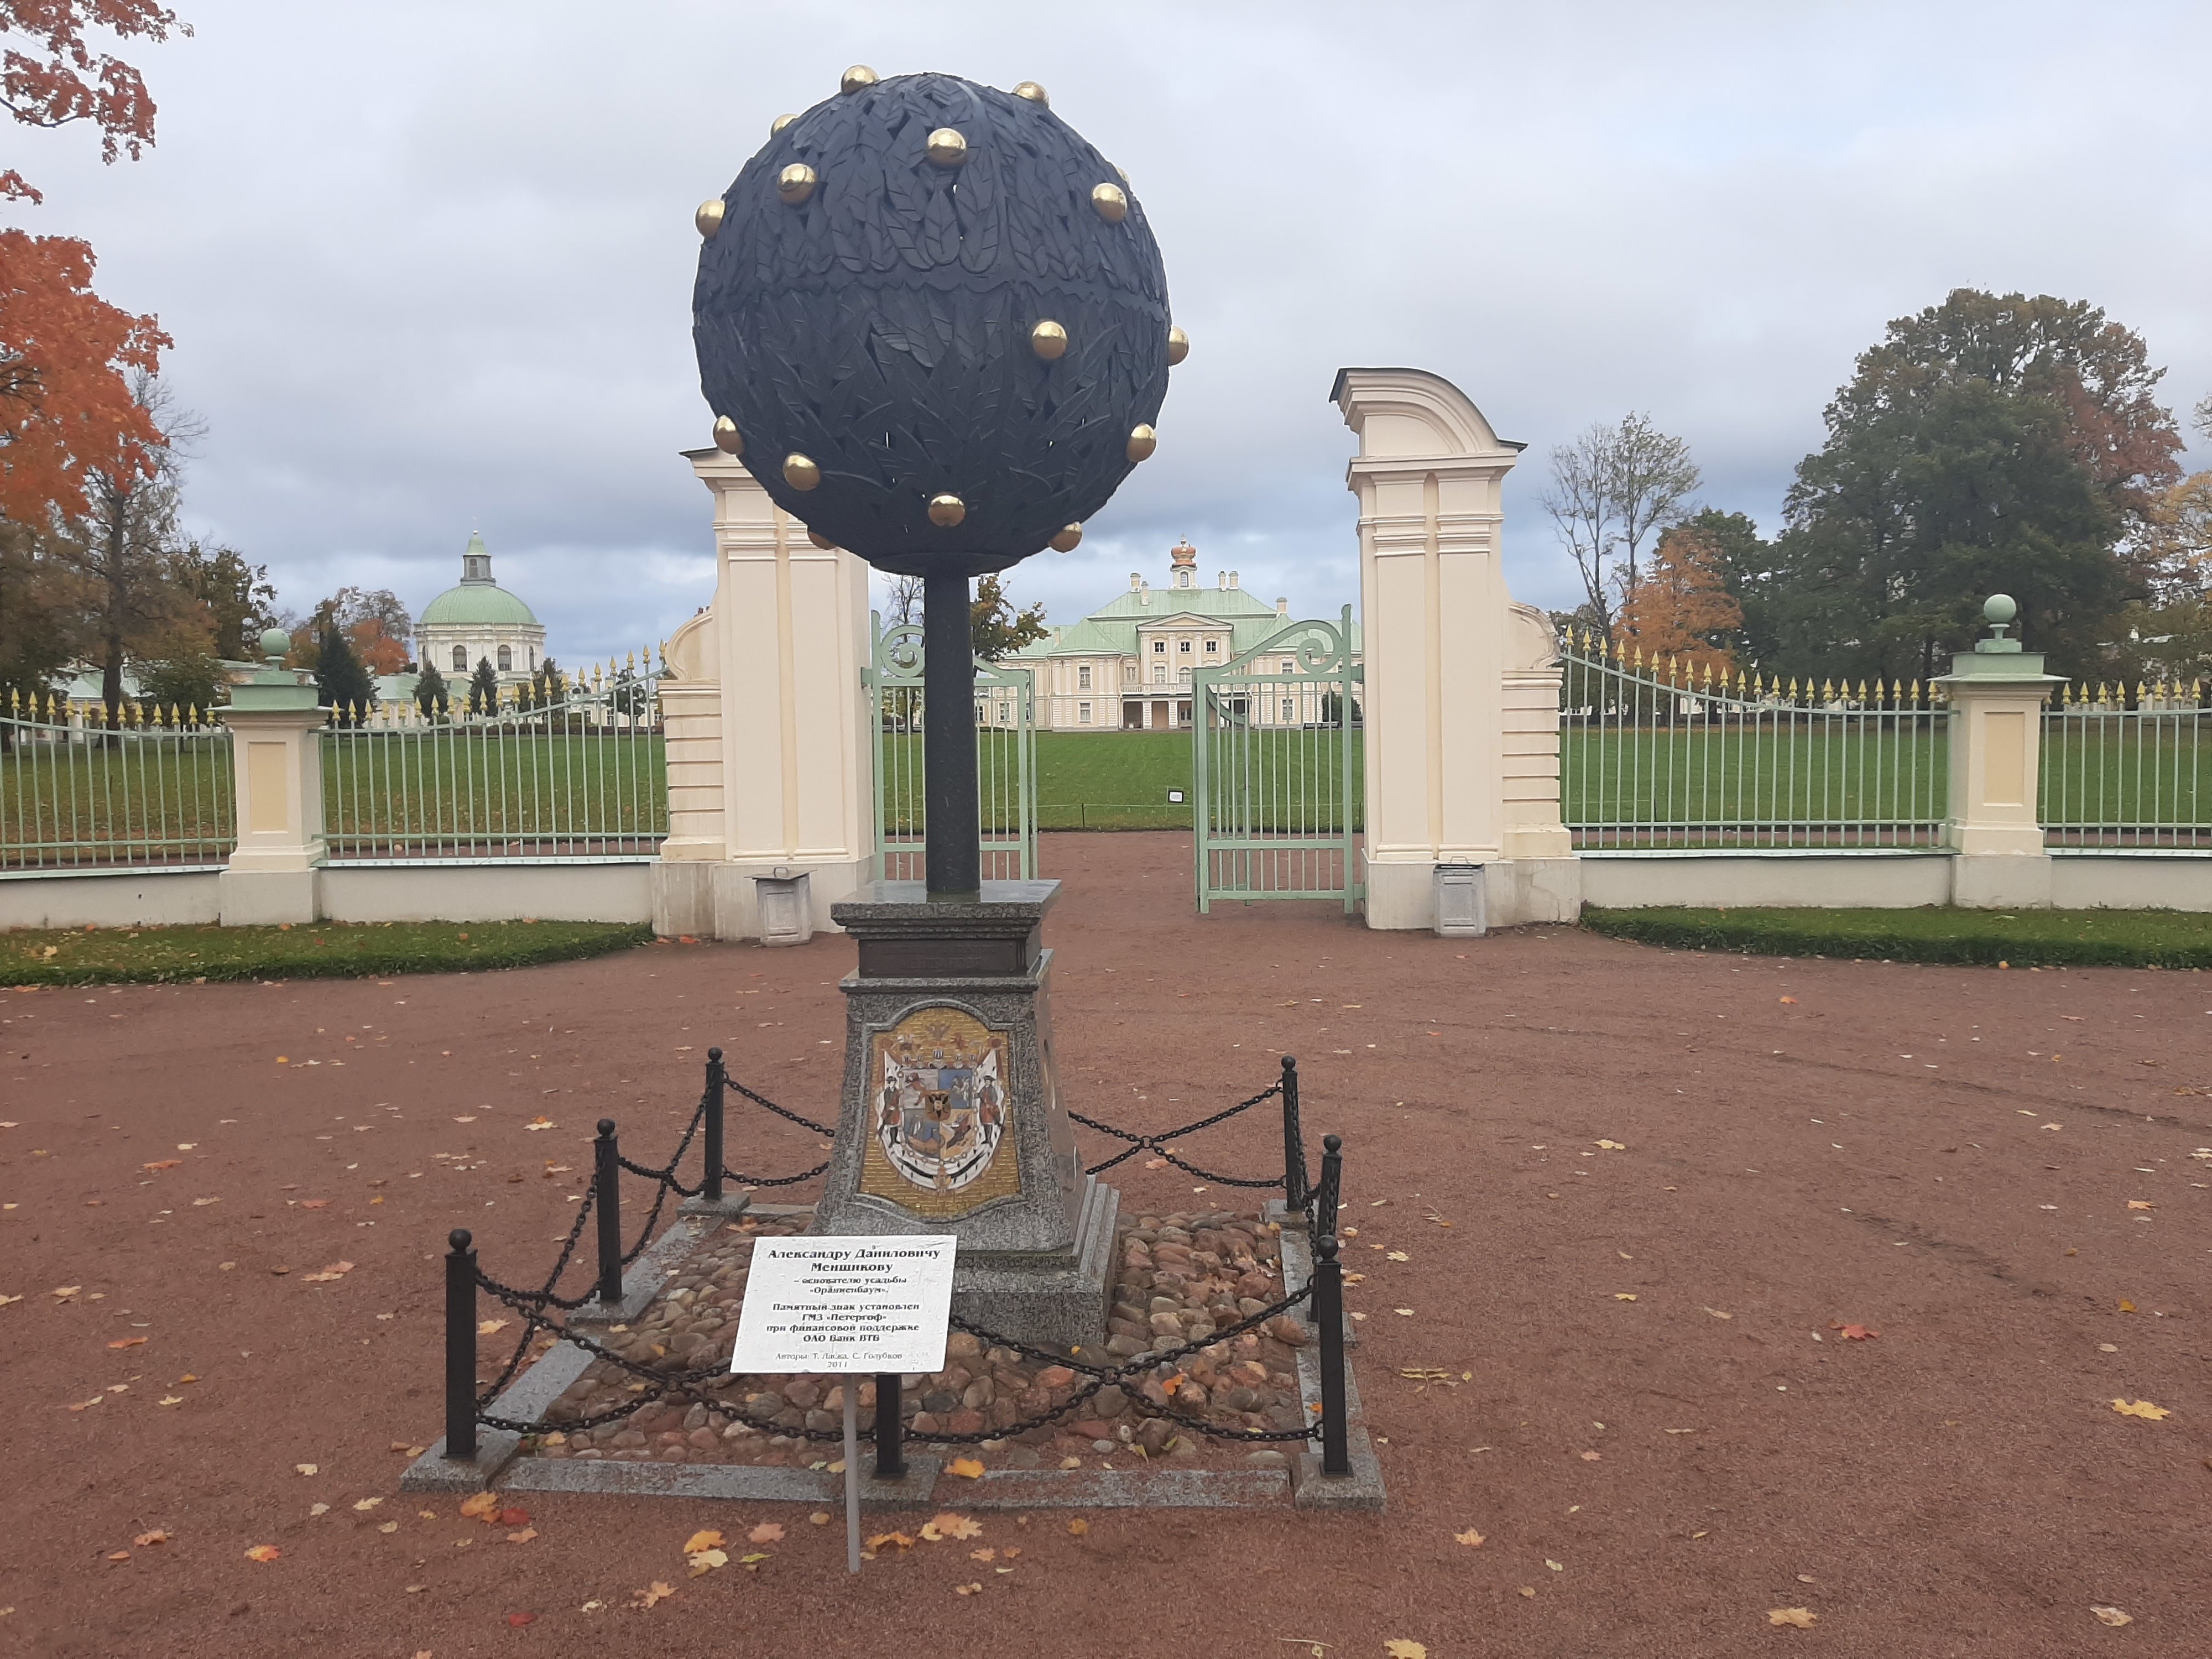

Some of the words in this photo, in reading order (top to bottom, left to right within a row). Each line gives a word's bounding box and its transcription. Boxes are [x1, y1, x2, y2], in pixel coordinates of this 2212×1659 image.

[768, 1249, 852, 1260] Александру
[854, 1249, 941, 1260] Даниловичу
[811, 1262, 893, 1273] Меншикову
[864, 1276, 907, 1285] усадьбы
[773, 1302, 828, 1311] Памятный
[859, 1304, 920, 1313] установлен
[826, 1313, 887, 1322] «Петергоф»
[766, 1325, 786, 1334] при
[790, 1323, 856, 1334] финансовой
[859, 1324, 920, 1333] поддержке
[830, 1334, 855, 1342] Банк
[859, 1334, 880, 1342] ВТБ
